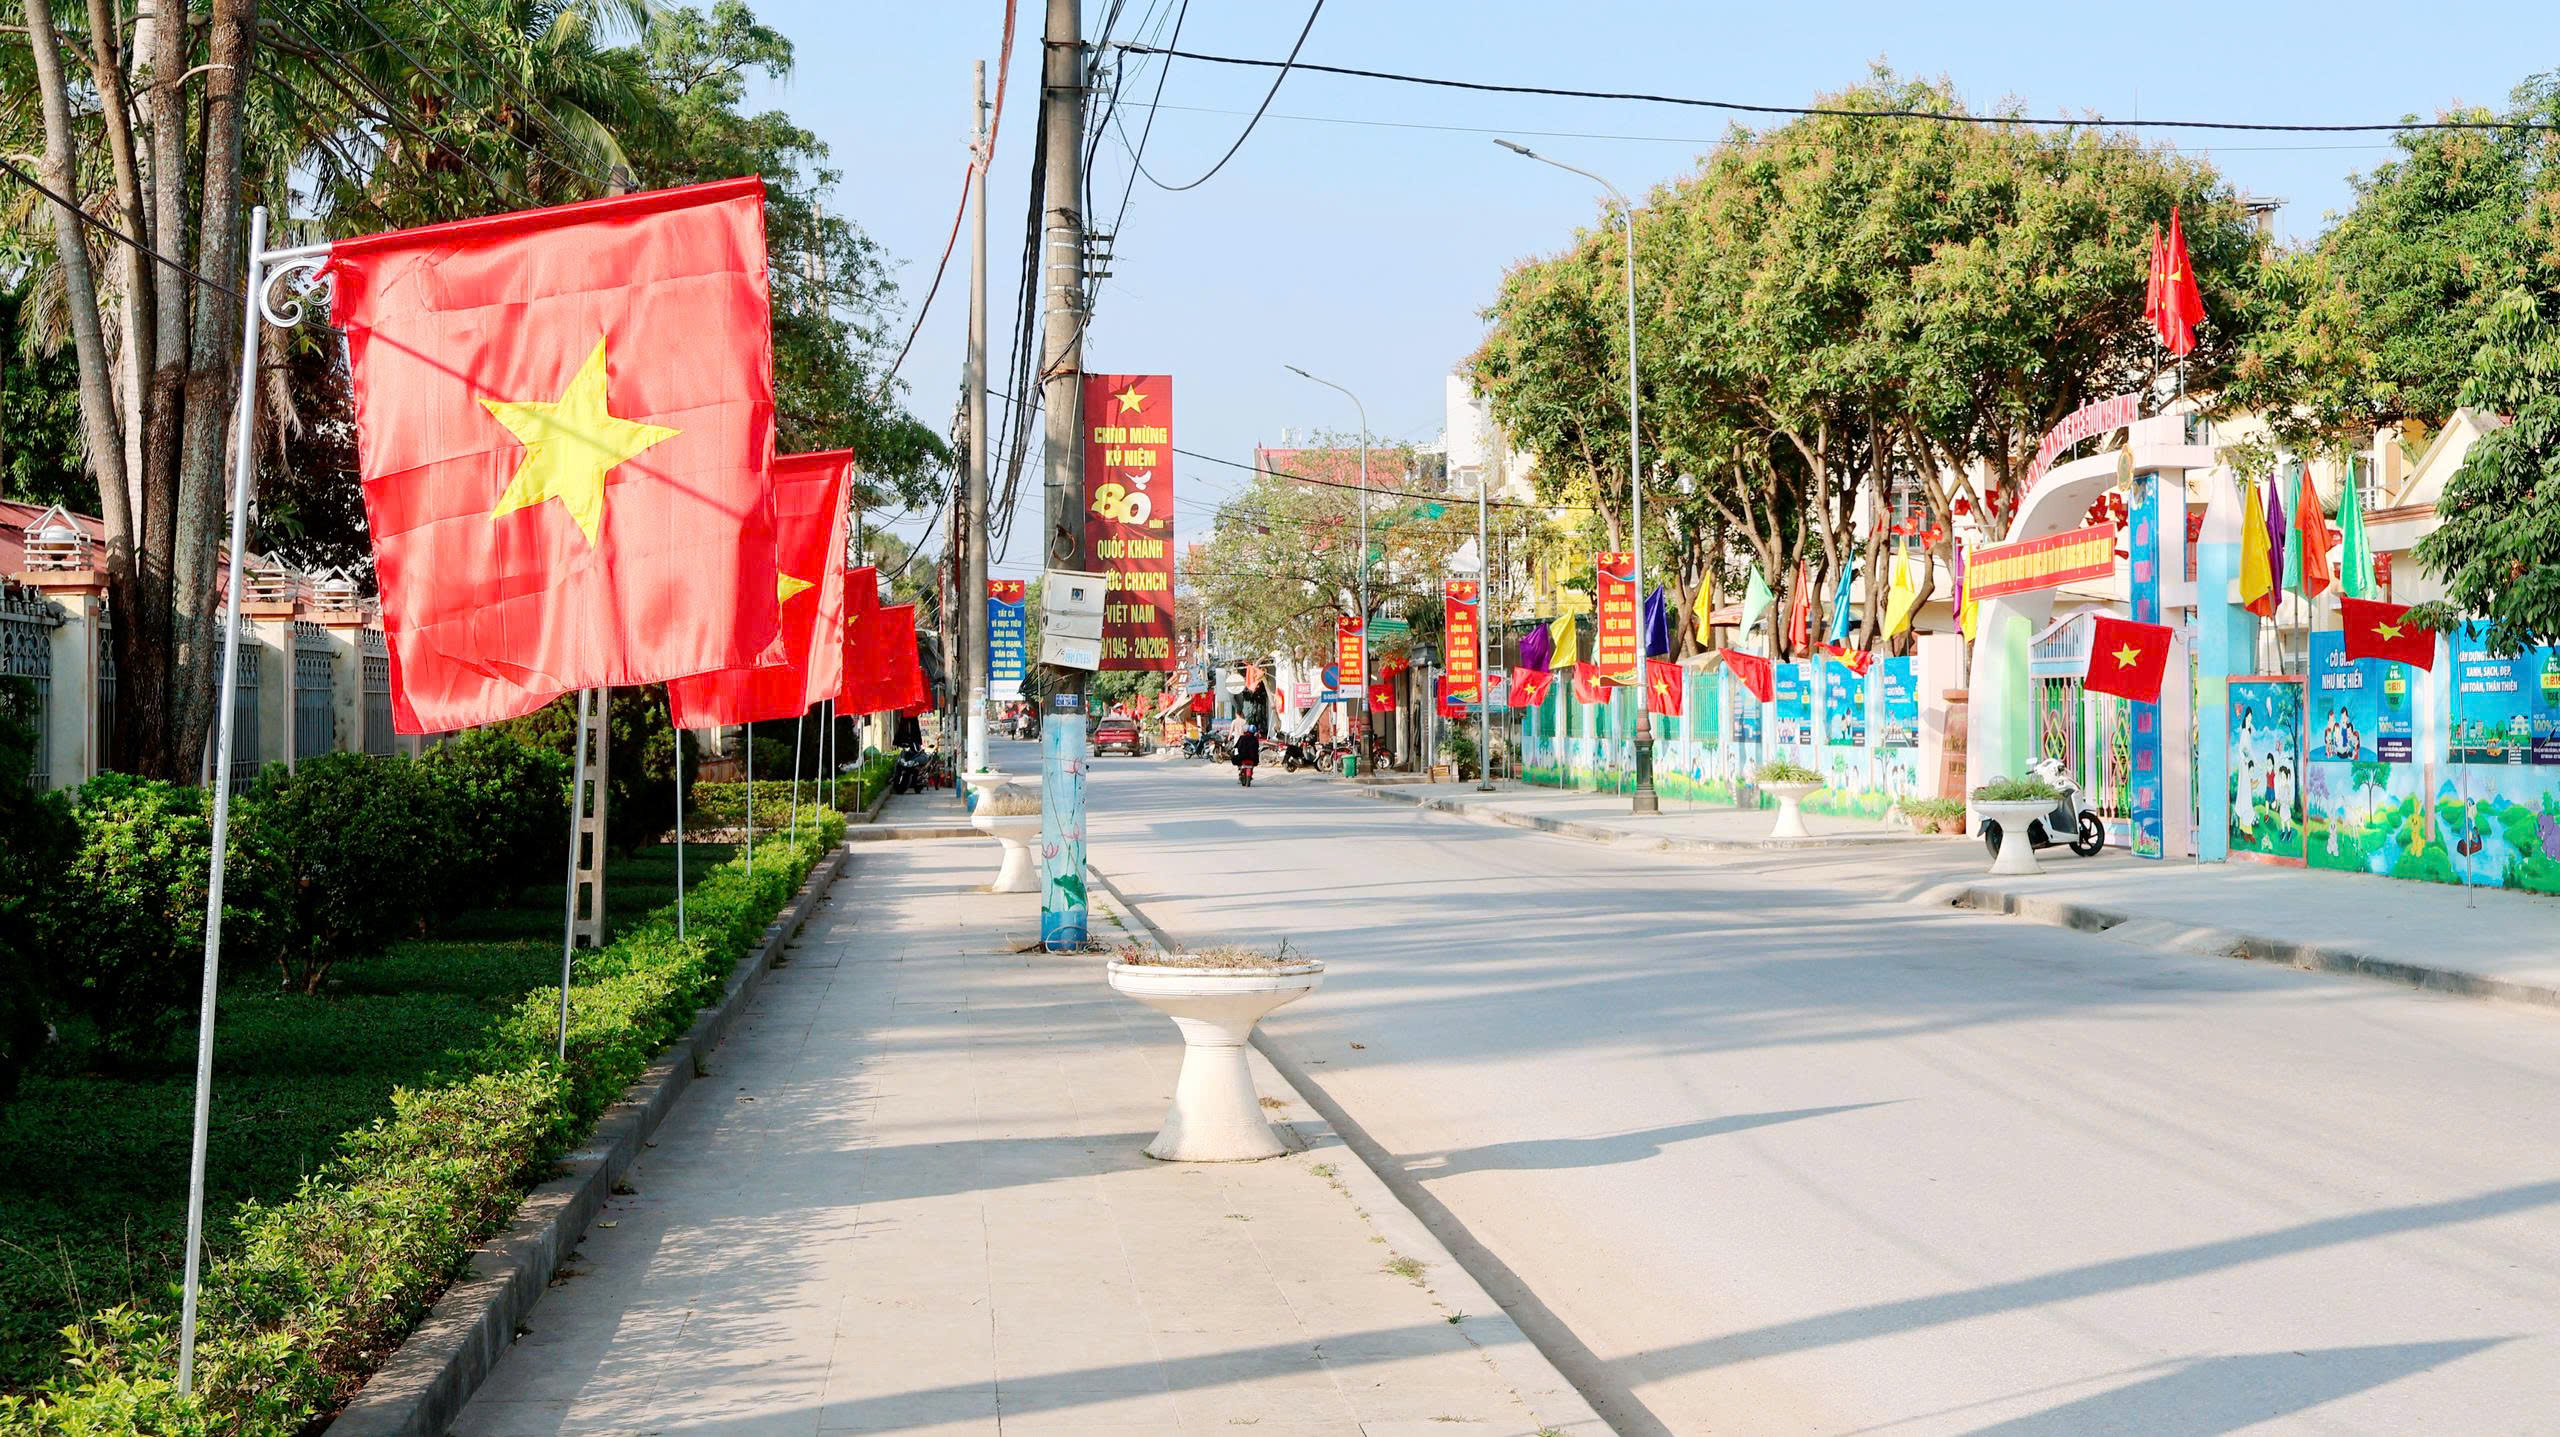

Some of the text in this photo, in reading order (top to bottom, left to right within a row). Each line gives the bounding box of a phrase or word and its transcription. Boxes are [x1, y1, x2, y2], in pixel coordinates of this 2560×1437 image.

[1094, 424, 1168, 444] CHÀO MỪNG
[1124, 447, 1157, 470] NIỆM
[1091, 483, 1152, 525] 80
[1097, 533, 1163, 560] QUỐC KHÁNH
[1105, 568, 1168, 592] ỚC CHXHCN
[1107, 601, 1155, 627] VIỆT NAM
[1101, 637, 1128, 659] 9/1945
[1135, 637, 1168, 659] 2/9/2025
[2322, 672, 2336, 689] NHƯ
[2336, 673, 2346, 691] MẸ
